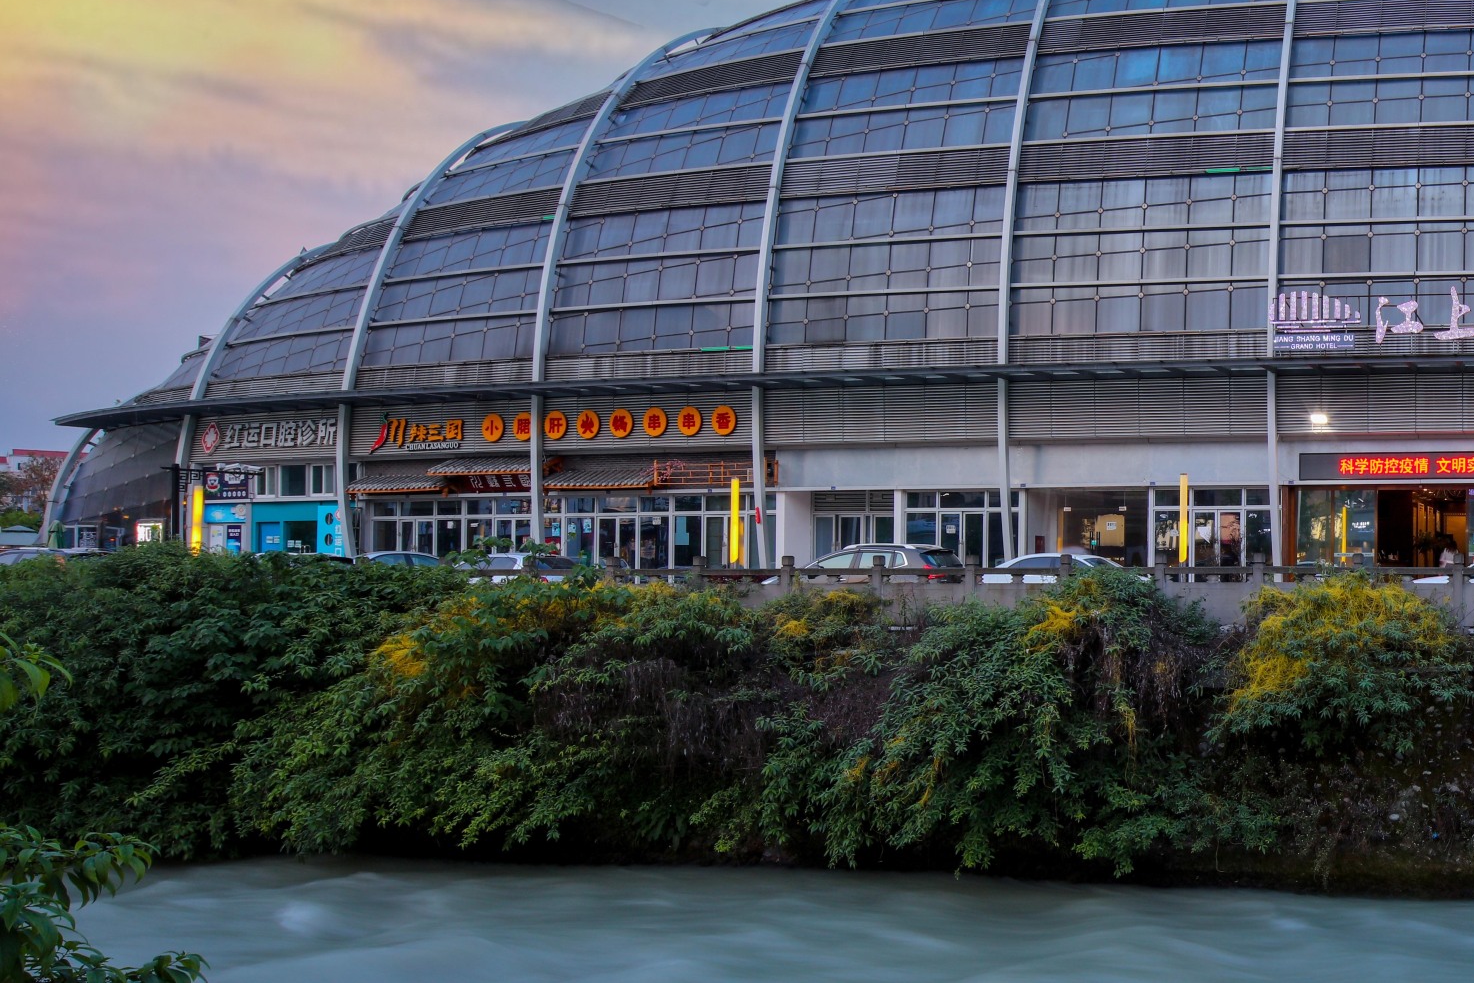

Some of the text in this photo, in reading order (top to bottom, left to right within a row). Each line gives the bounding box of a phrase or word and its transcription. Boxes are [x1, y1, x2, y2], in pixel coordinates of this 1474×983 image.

[224, 418, 337, 448] 红运口腔诊所
[370, 413, 463, 453] 川辣三国
[405, 441, 459, 451] CHUANLASANGUO
[1340, 457, 1429, 475] 科学防控疫情
